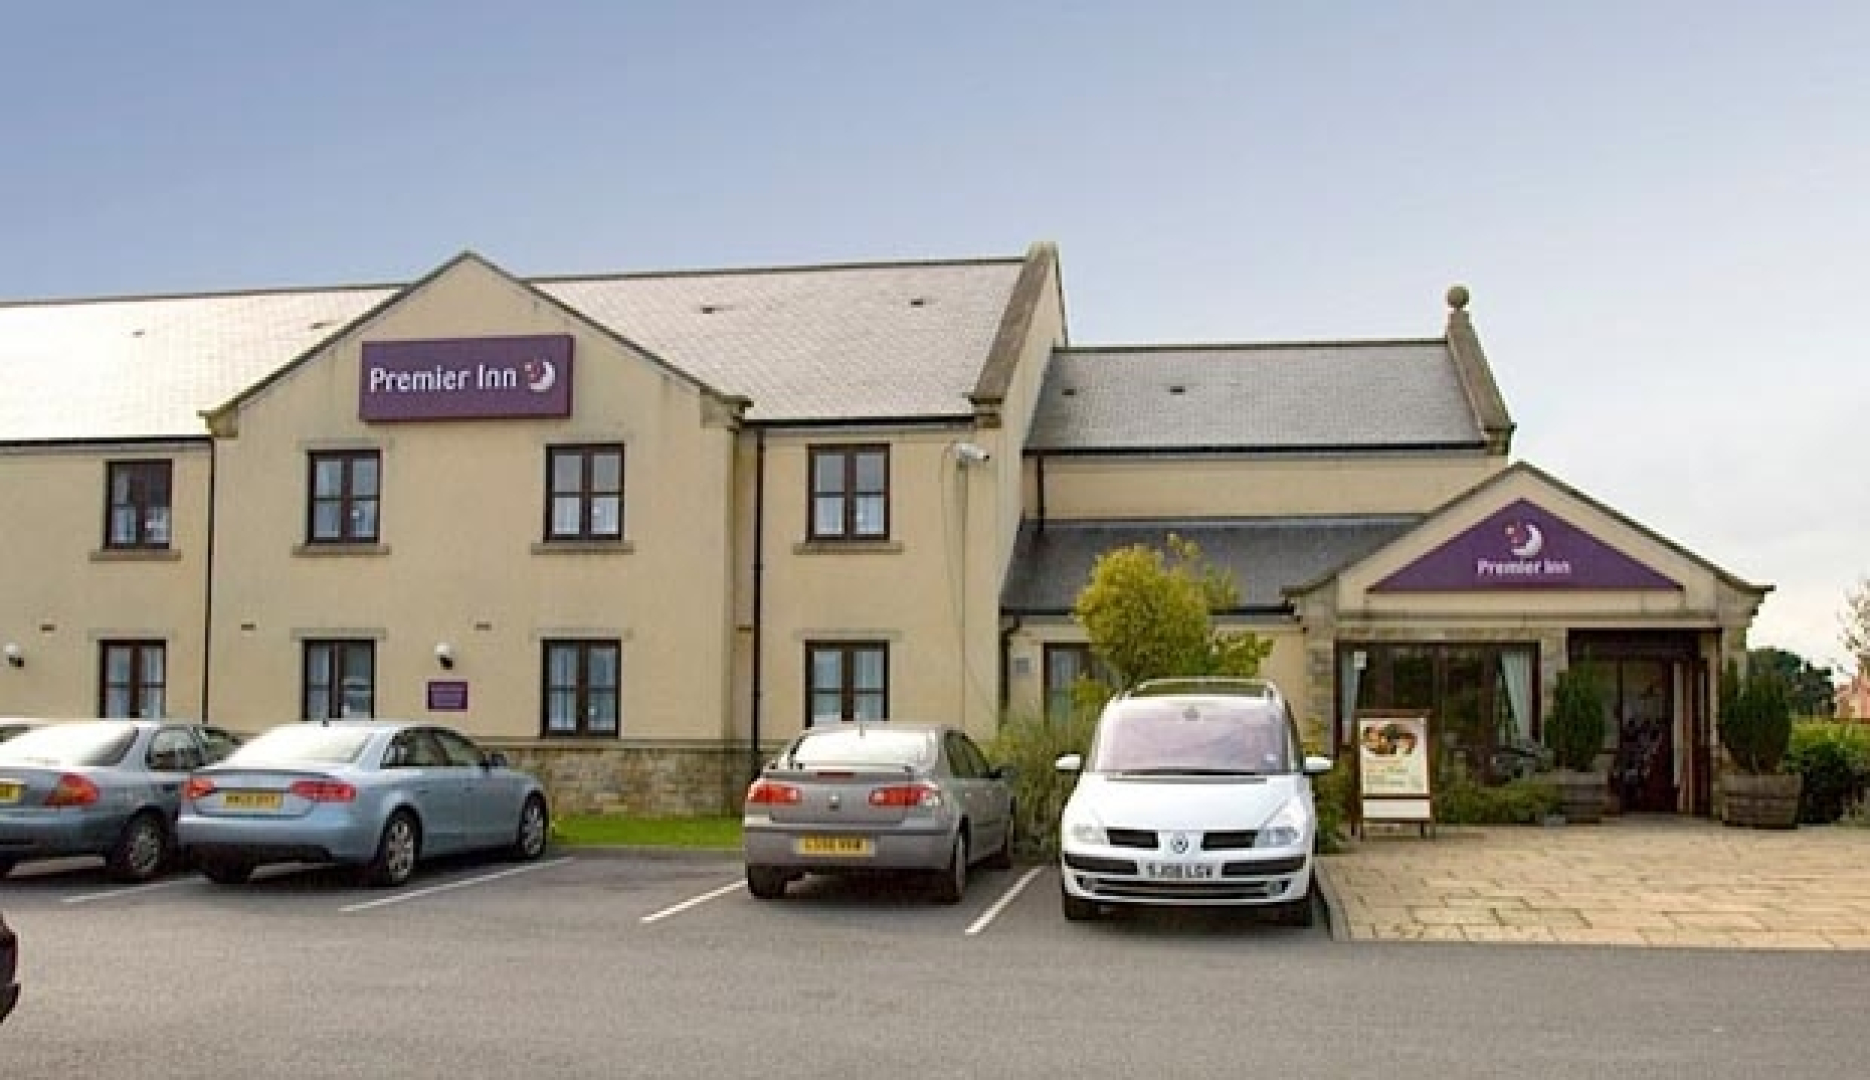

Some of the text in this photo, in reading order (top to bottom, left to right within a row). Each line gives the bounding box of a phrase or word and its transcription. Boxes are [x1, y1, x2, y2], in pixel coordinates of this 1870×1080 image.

[370, 362, 517, 392] Premier Inn
[1476, 558, 1571, 576] Premier Inn
